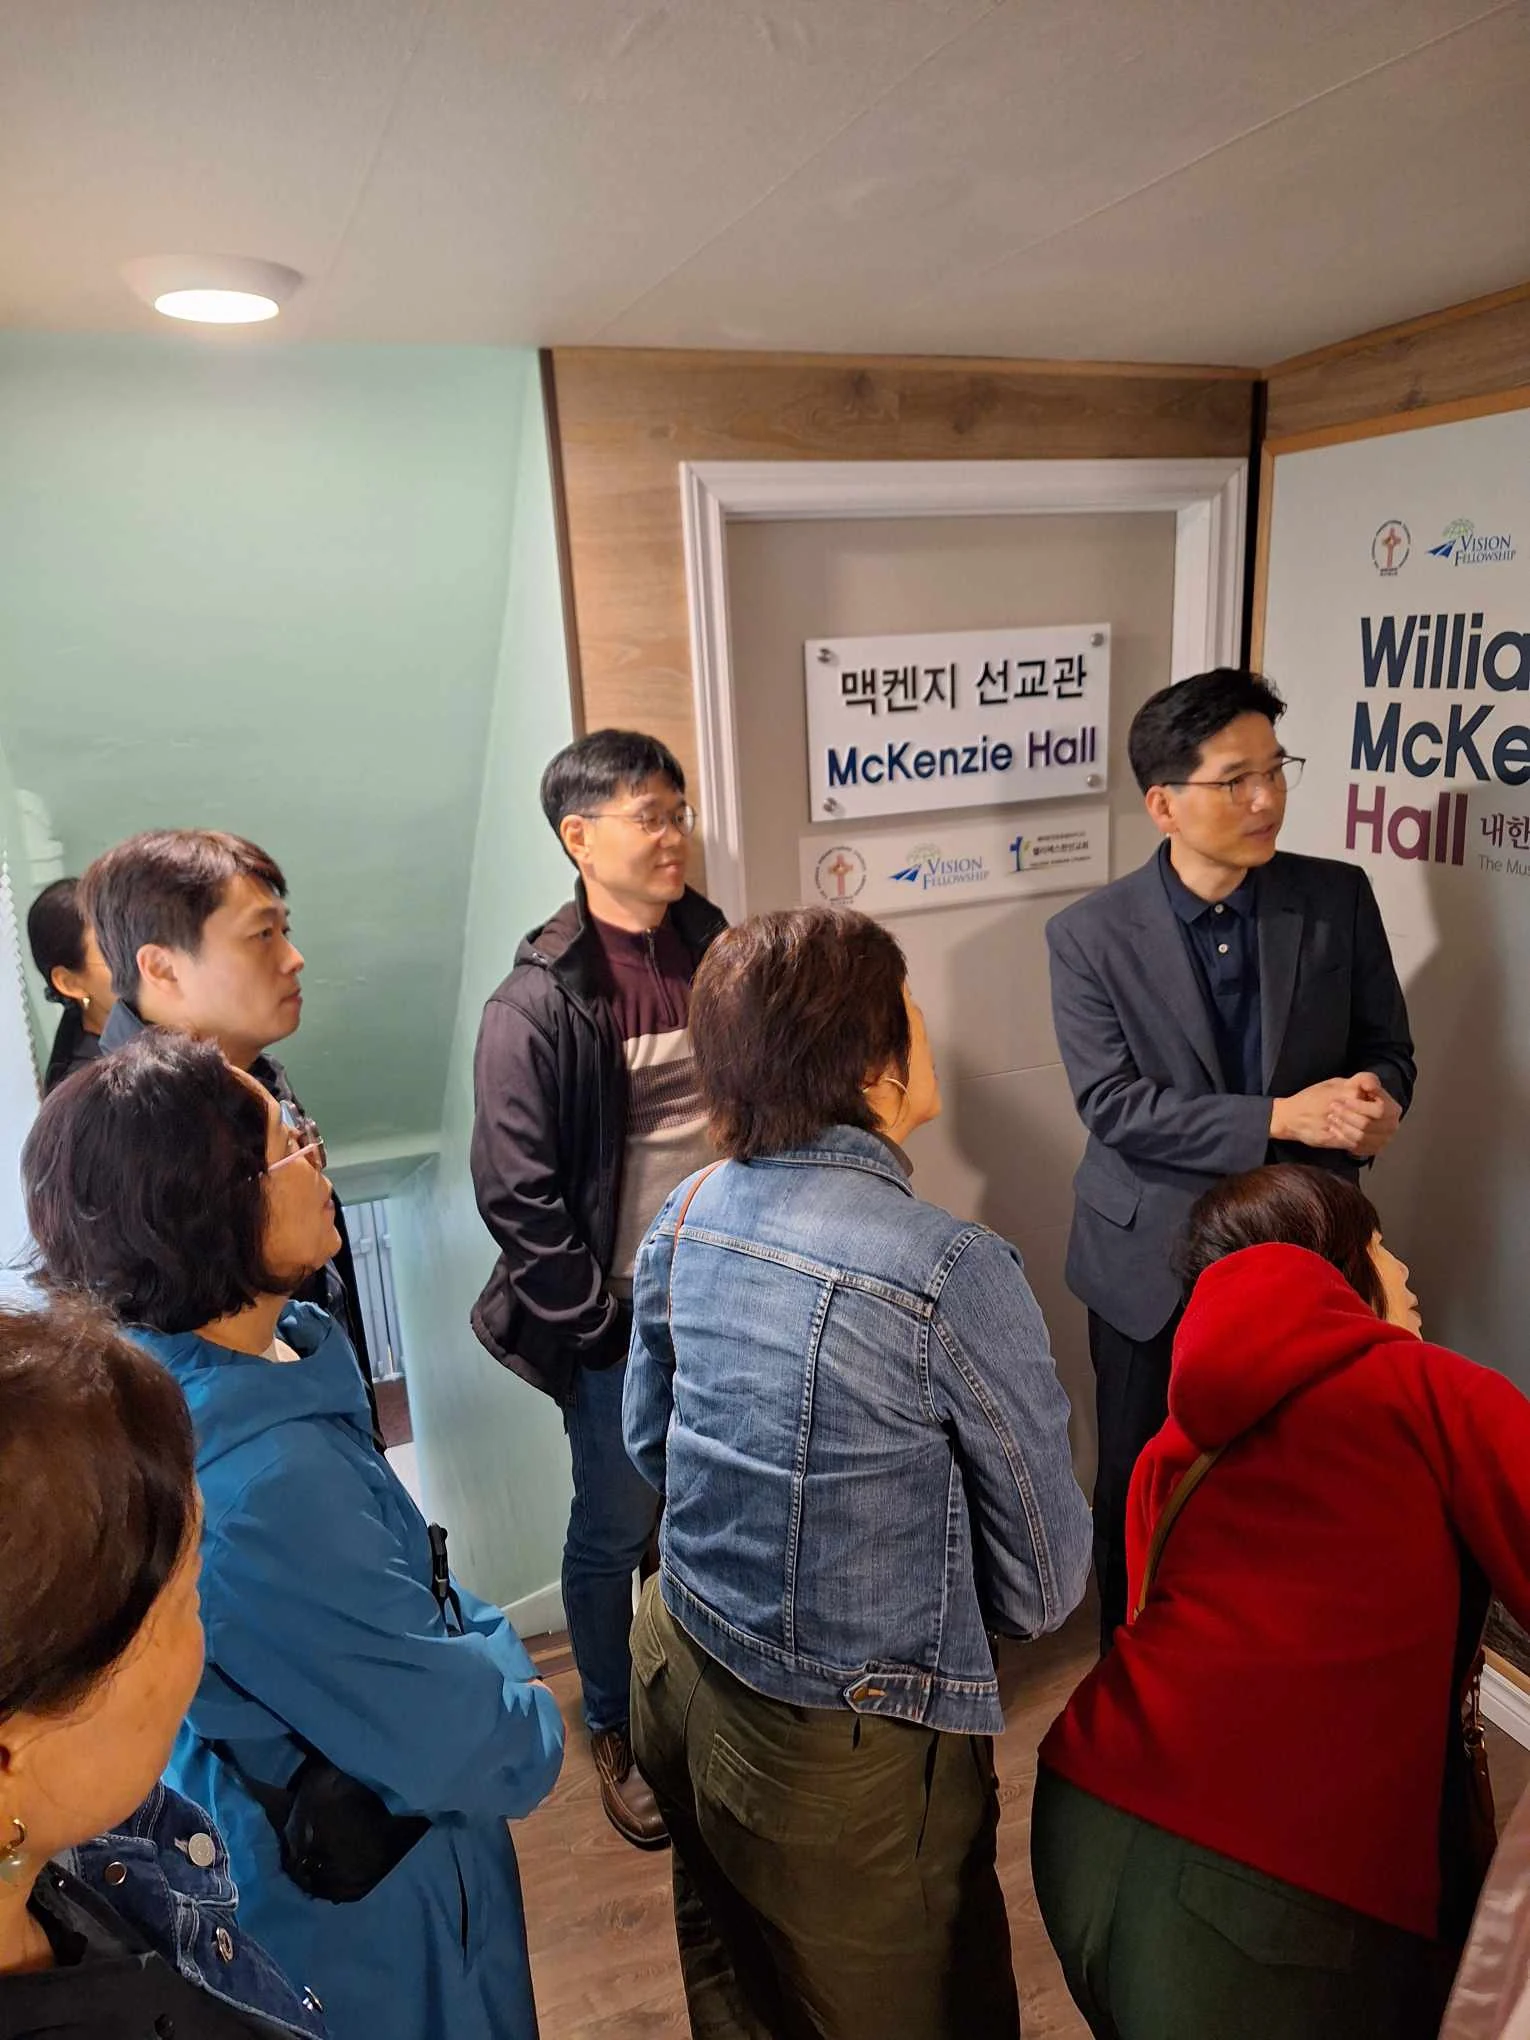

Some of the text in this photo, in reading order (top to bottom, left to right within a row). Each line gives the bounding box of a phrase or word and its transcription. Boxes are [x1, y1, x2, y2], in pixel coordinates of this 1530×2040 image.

[1454, 549, 1516, 567] FELLOWSHIP
[1461, 534, 1511, 551] VISION
[1361, 613, 1530, 691] Willia
[841, 654, 1087, 716] 맥켄지 선교관
[827, 726, 1096, 787] McKenzie Hall
[1351, 702, 1530, 786] McKe
[1345, 783, 1468, 866] Hall
[923, 870, 990, 890] FELLOWSHIP
[928, 857, 983, 875] VISION
[1478, 854, 1503, 872] The
